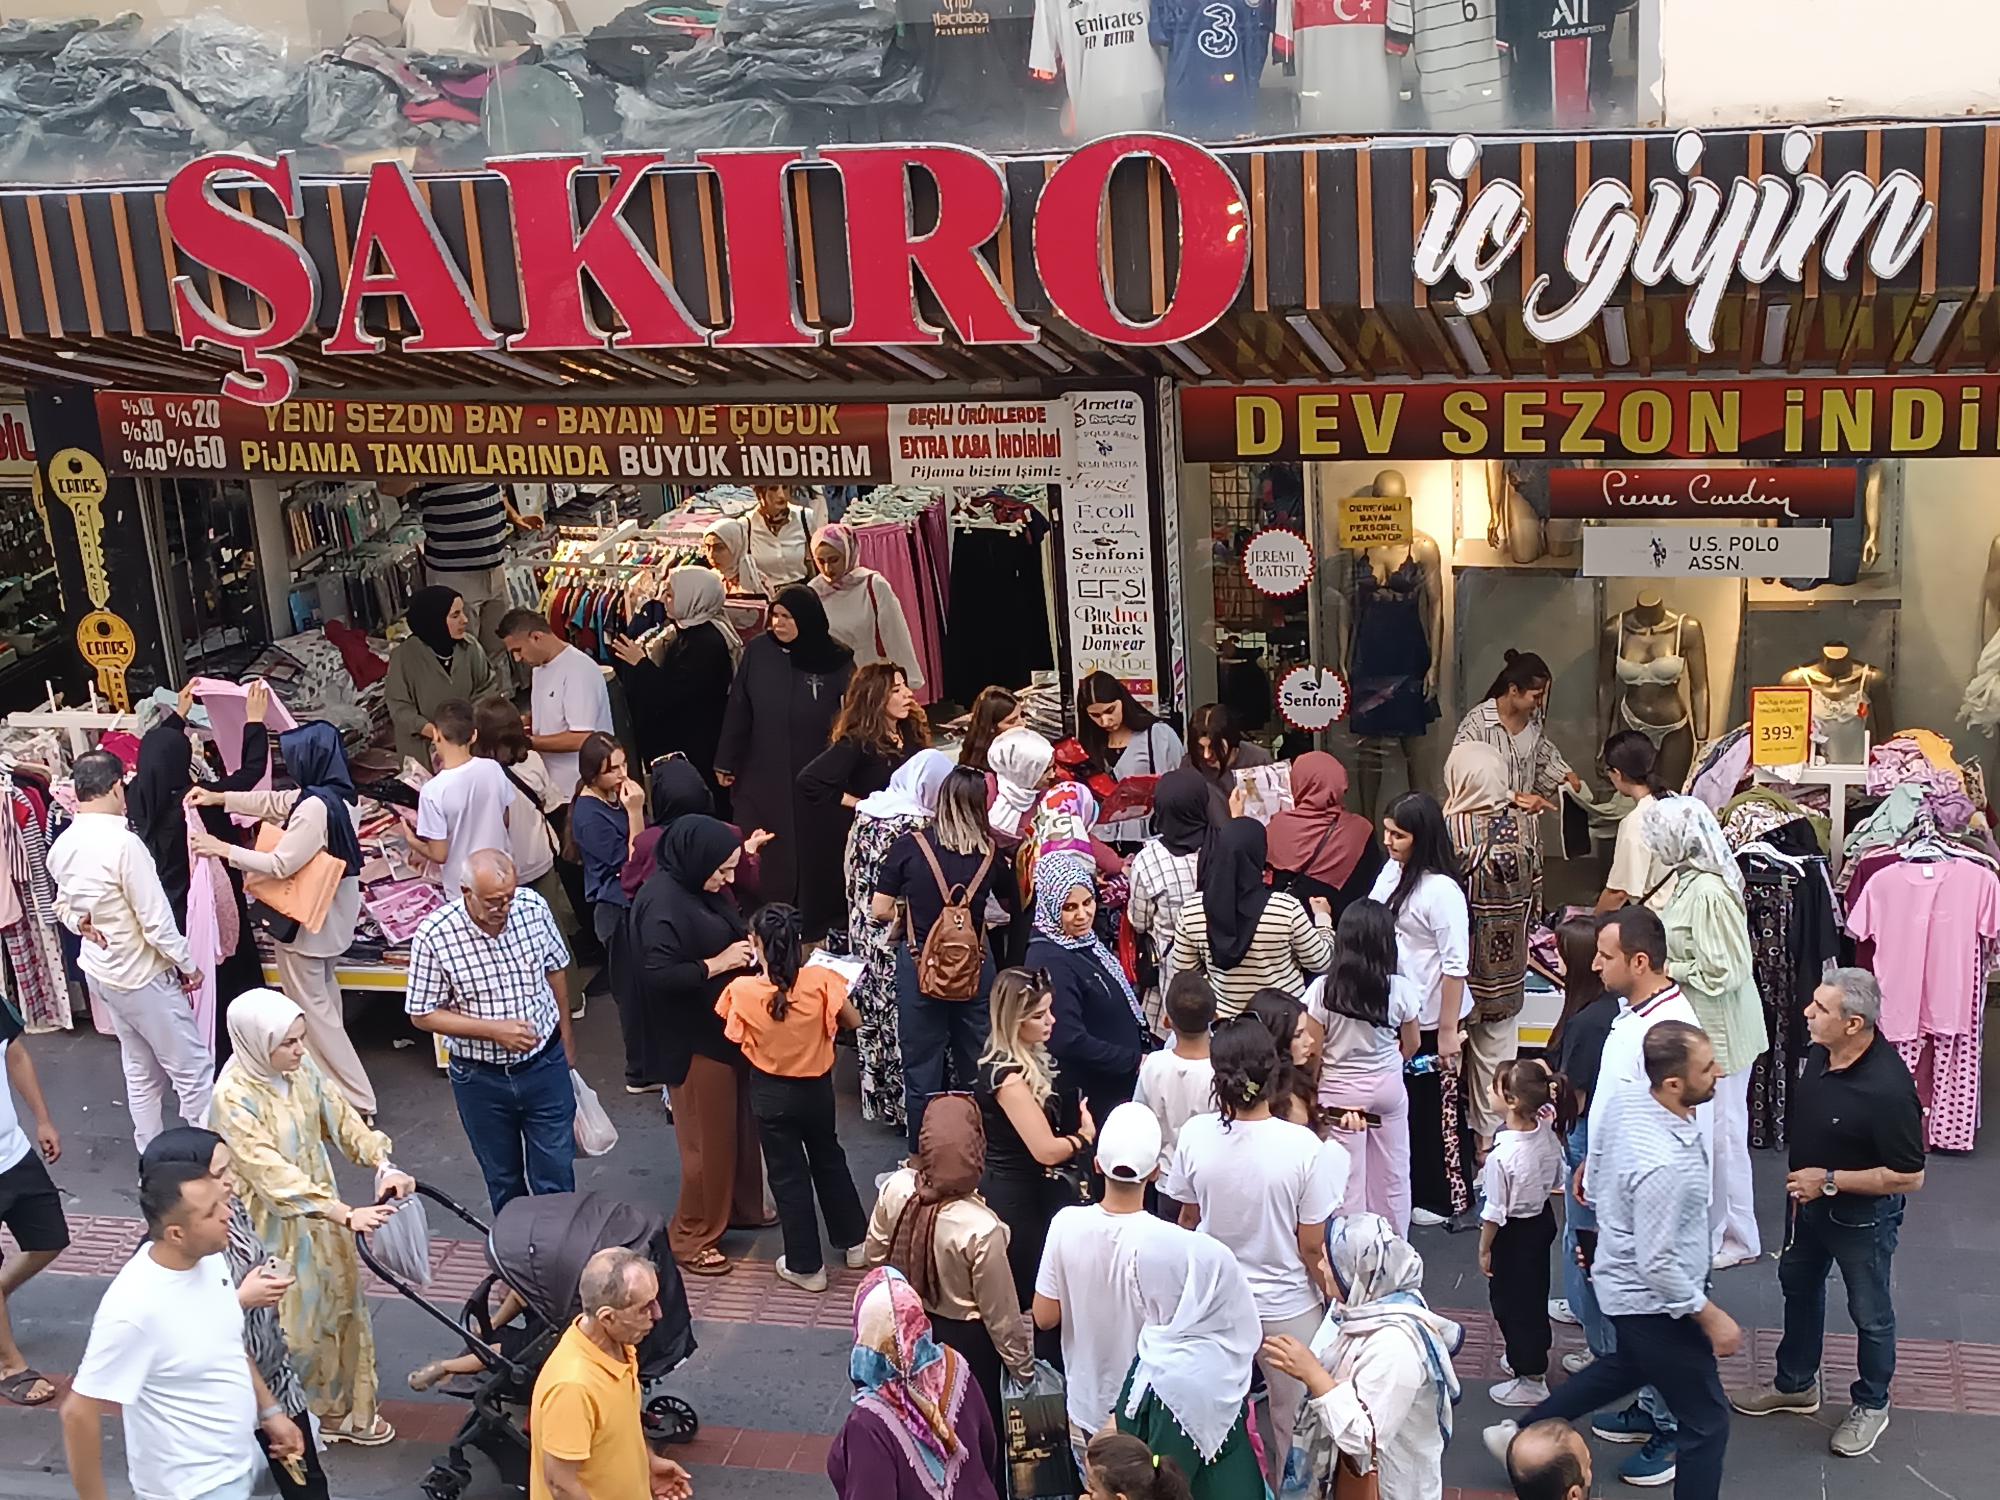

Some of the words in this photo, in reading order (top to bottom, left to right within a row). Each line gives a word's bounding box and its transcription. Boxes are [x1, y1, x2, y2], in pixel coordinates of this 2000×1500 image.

[1075, 11, 1144, 36] Emirates
[1198, 3, 1238, 58] 3
[1522, 127, 1935, 353] giyim
[121, 399, 155, 416] %10
[166, 399, 221, 428] %20
[1073, 398, 1134, 411] Arnetta
[346, 403, 453, 433] SEZON
[464, 405, 524, 434] BAY
[557, 406, 664, 434] BAYAN
[674, 406, 717, 434] VE
[730, 405, 840, 444] ÇOCUK
[957, 404, 1047, 425] ÜRÜNLERDE
[1235, 392, 1404, 456] DEV
[1441, 390, 1741, 454] SEZON
[121, 419, 164, 443] %30
[123, 447, 168, 471] %40
[166, 436, 227, 469] %50
[368, 443, 610, 476] TAKIMLARINDA
[619, 436, 728, 476] BÜYÜK
[900, 435, 949, 459] EXTRA
[969, 465, 1011, 478] bizim
[1349, 523, 1403, 532] PERSONEL
[1689, 537, 1722, 552] U.S.
[1729, 536, 1779, 552] POLO
[1072, 547, 1144, 560] Senfoni
[1250, 551, 1294, 565] JEREMI
[1255, 565, 1307, 577] BATISTA
[1688, 556, 1744, 570] ASSN.
[1091, 624, 1144, 635] Black
[1082, 635, 1146, 650] Donwear
[1283, 692, 1341, 707] Senfoni
